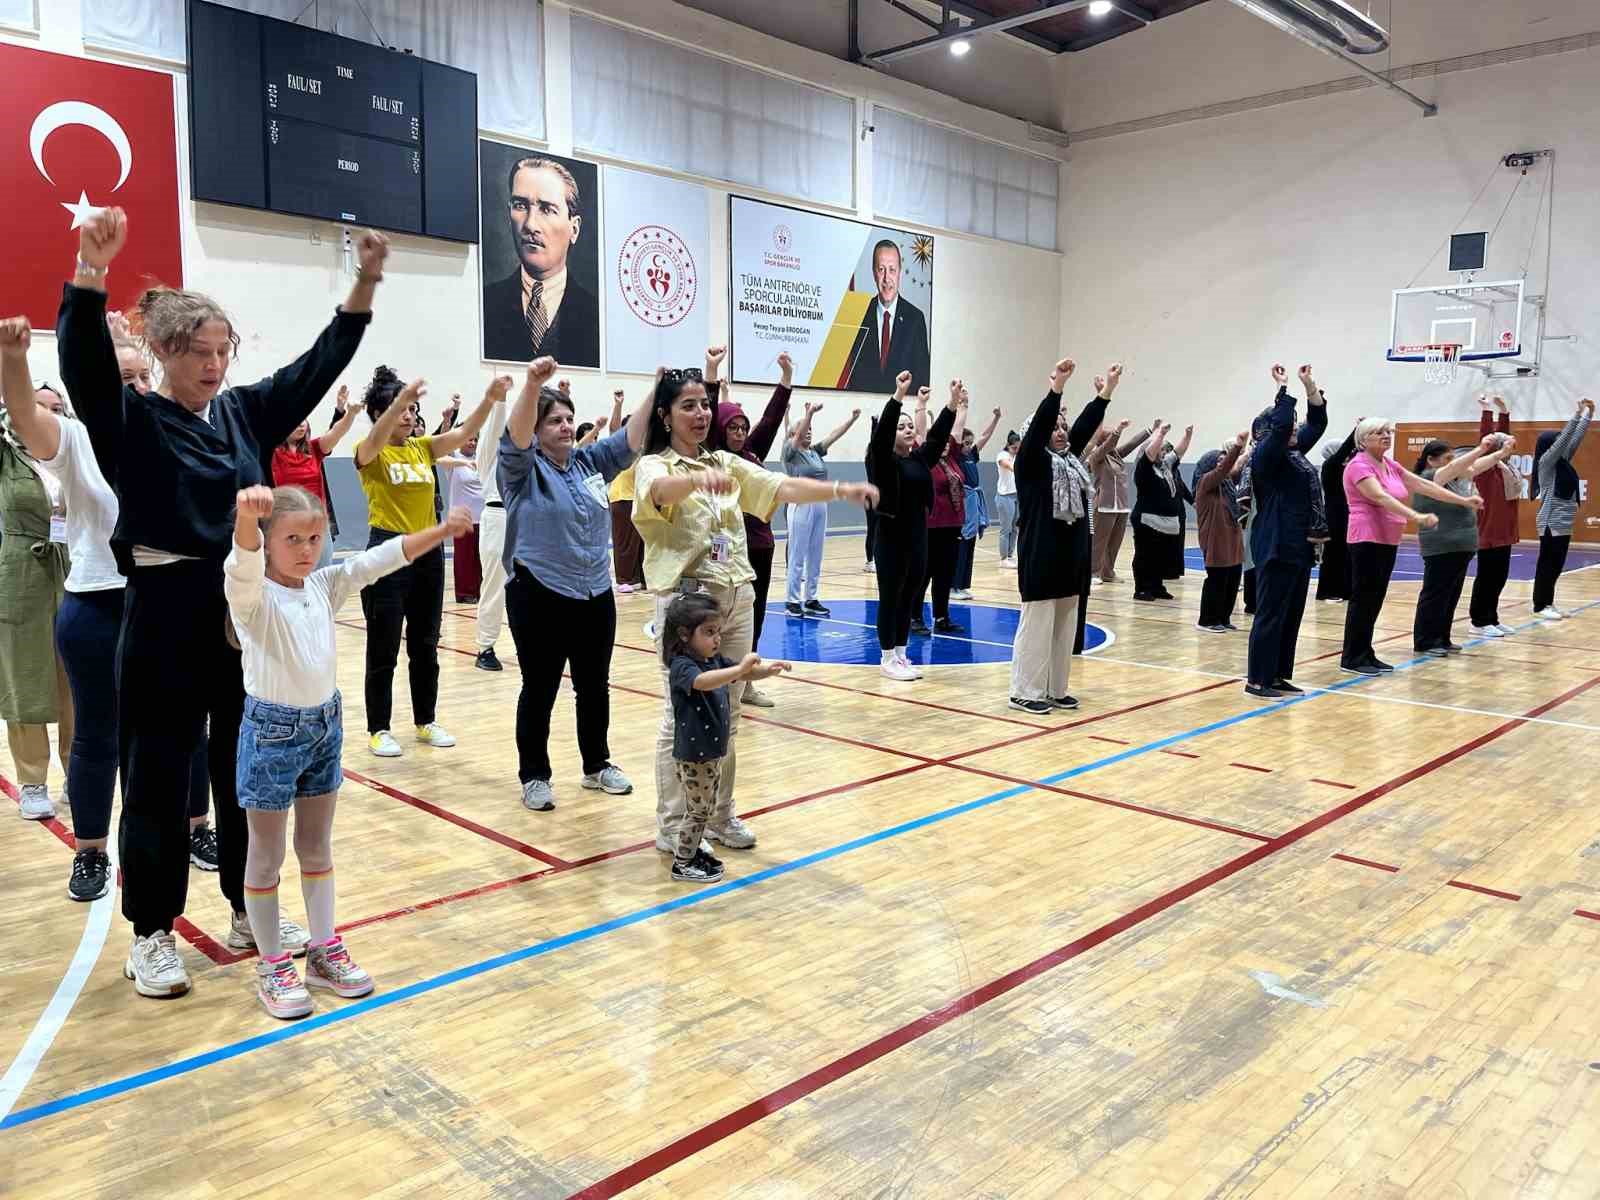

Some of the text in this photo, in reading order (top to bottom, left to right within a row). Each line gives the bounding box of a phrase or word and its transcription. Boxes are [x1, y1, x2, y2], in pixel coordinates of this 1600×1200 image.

[335, 65, 353, 80] TIME
[287, 73, 322, 96] FAUL/SET
[372, 95, 404, 115] FAUL/SET
[337, 158, 360, 173] PERIOD
[740, 272, 822, 297] TÜM ANTRENÖR VE
[743, 288, 819, 309] SPORCULARIMIZA
[783, 305, 824, 321] DİLİYORUM
